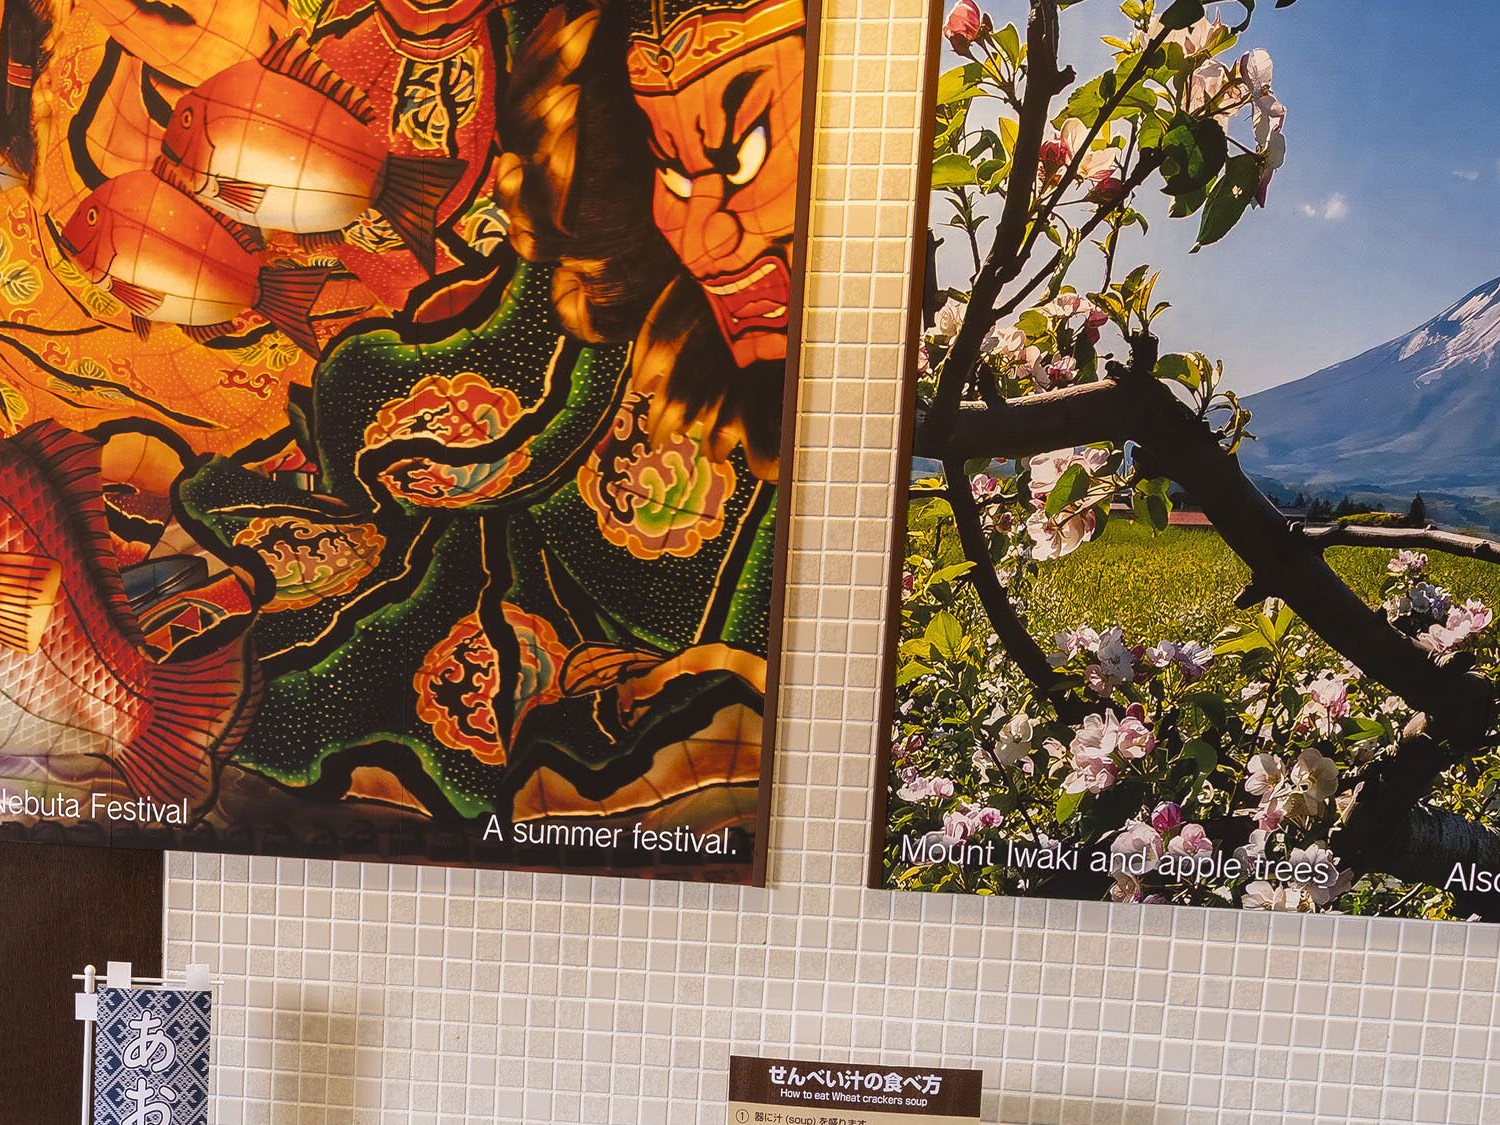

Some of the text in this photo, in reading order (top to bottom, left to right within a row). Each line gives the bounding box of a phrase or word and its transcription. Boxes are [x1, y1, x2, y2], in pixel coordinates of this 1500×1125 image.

[90, 792, 188, 824] Festival
[482, 814, 737, 854] A summer festival.
[901, 834, 1329, 884] Mount Iwaki and apple trees
[768, 1065, 943, 1095] せんべい汁の食べ方
[780, 1088, 927, 1107] How to eat Wheat crackers soup
[755, 1111, 783, 1123] 器に汁
[786, 1115, 816, 1125] (soup)
